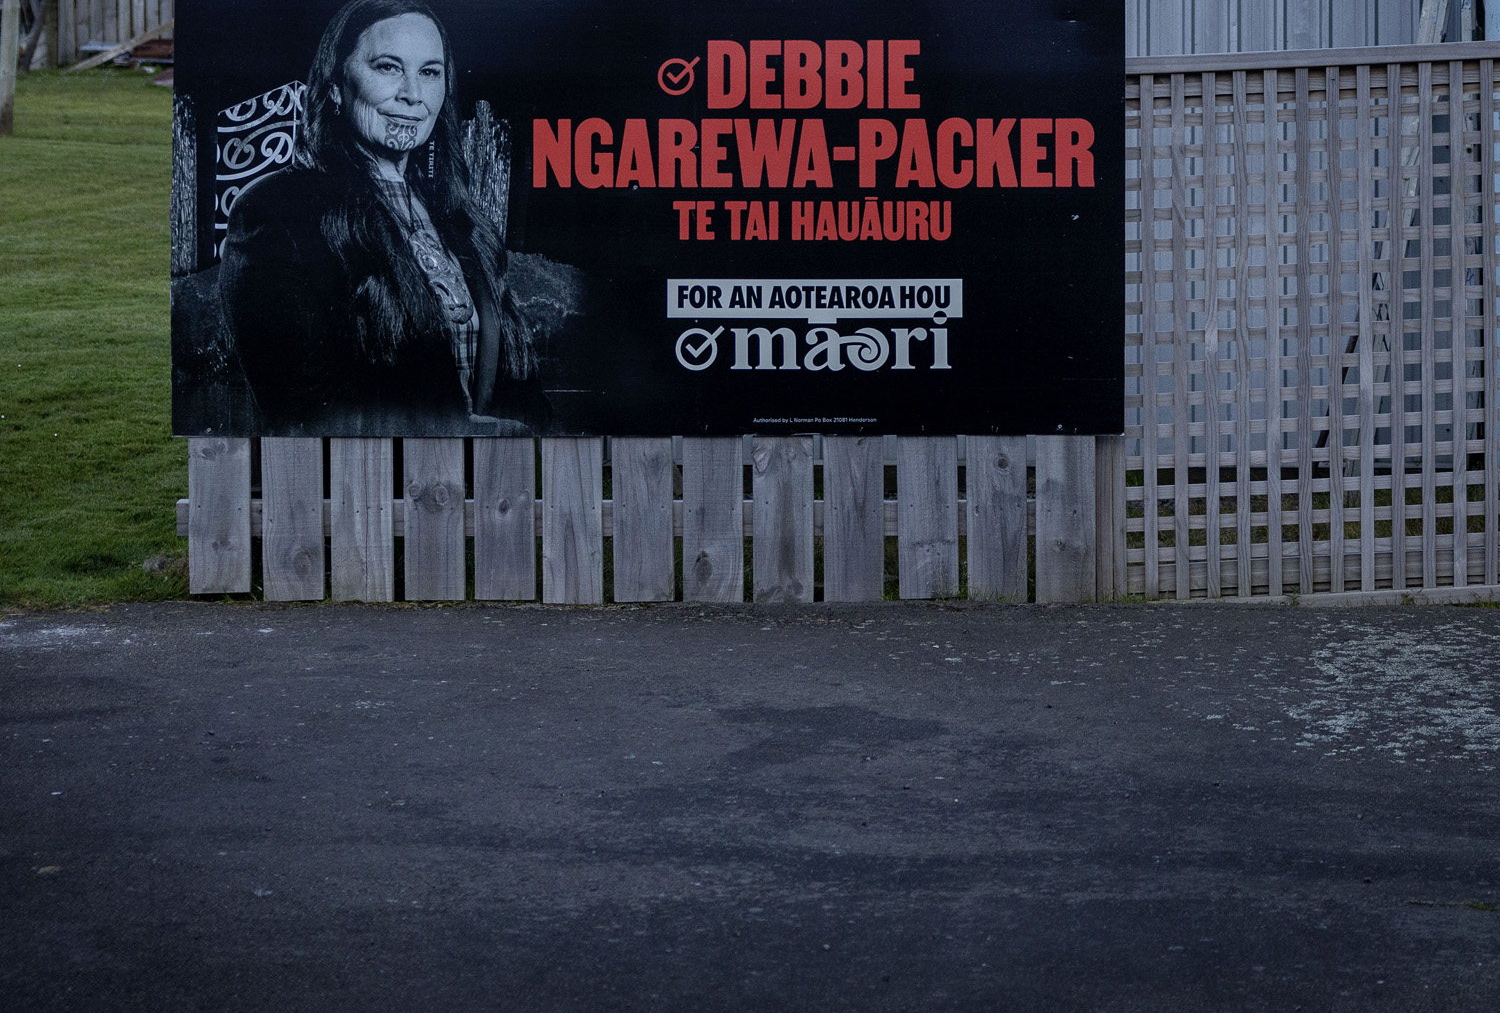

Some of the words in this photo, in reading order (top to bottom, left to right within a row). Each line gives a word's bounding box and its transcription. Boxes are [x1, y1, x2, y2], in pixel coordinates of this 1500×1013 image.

[708, 40, 920, 108] DEBBIE
[533, 118, 1095, 188] NGAREWA-PACKER
[673, 201, 715, 241] TE
[725, 201, 778, 241] TAI
[791, 197, 951, 241] HAUĀURU
[678, 286, 722, 309] FOR
[729, 286, 762, 309] AN
[769, 286, 895, 309] AOTEAROA
[900, 286, 950, 309] HOU
